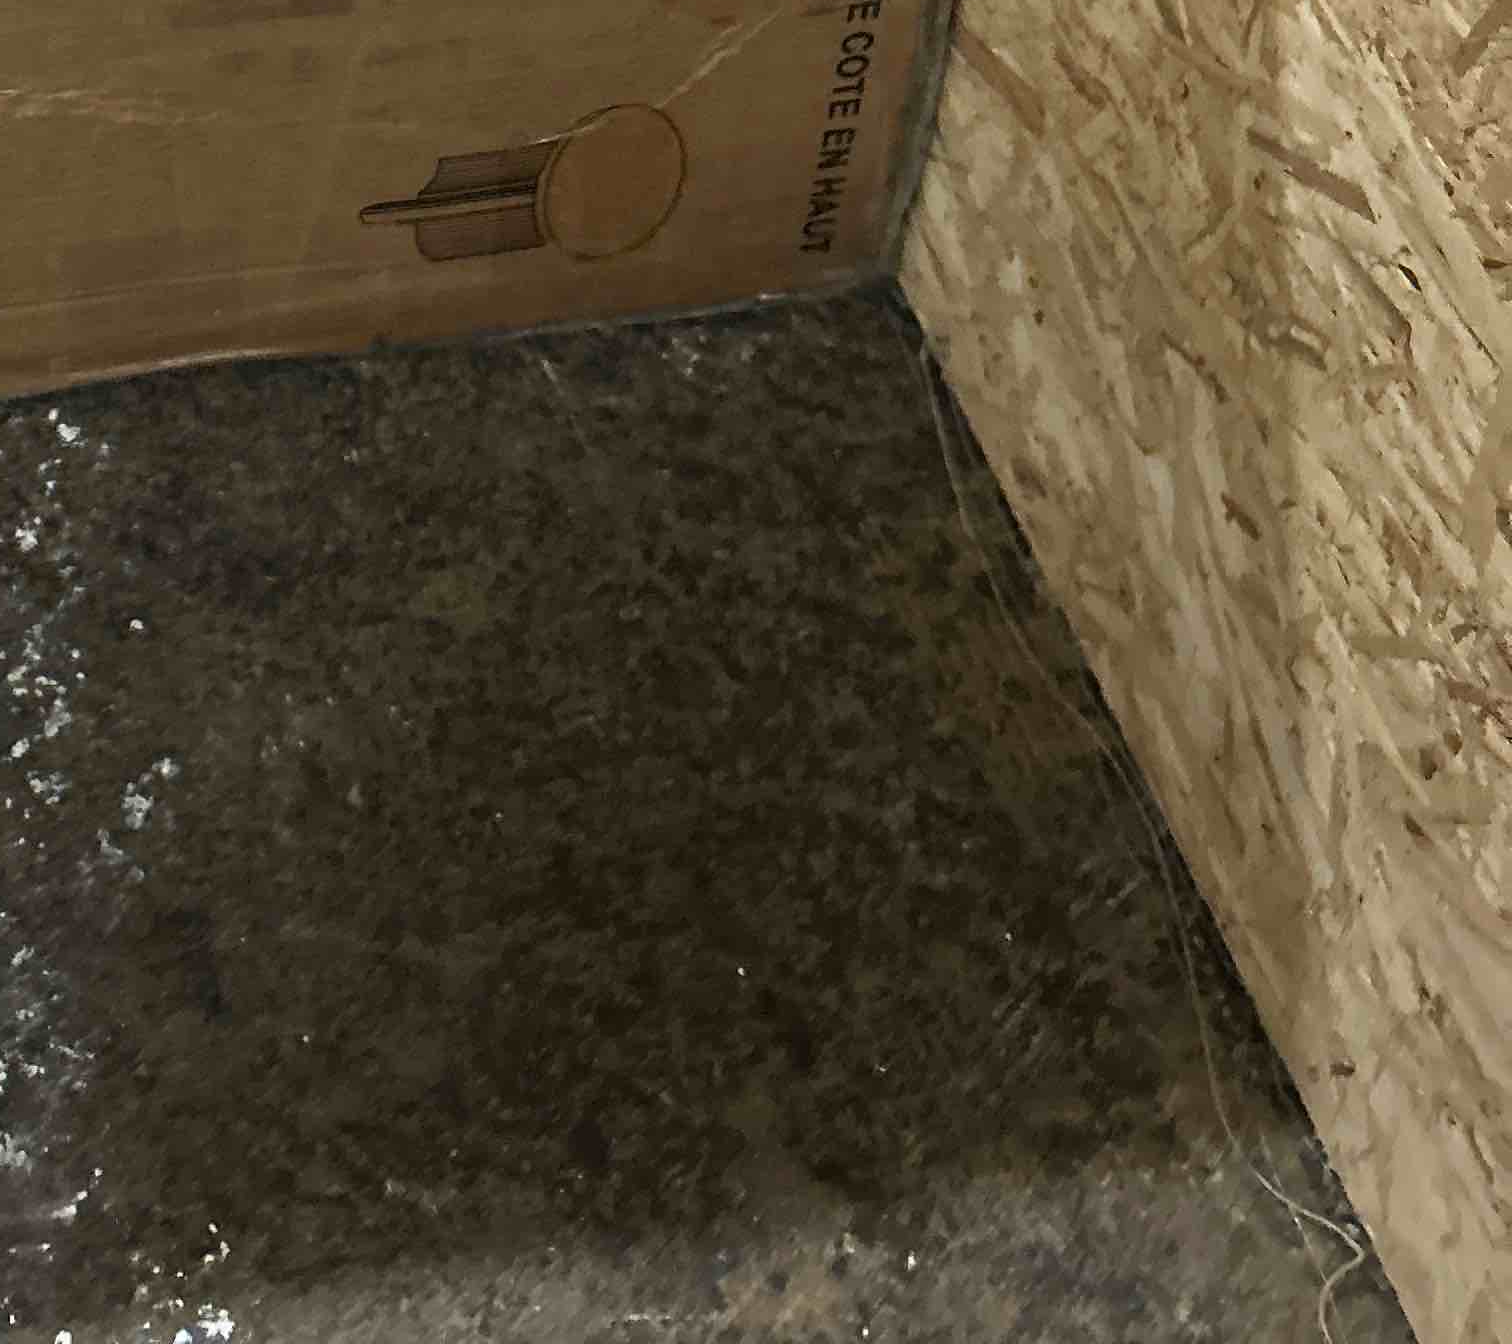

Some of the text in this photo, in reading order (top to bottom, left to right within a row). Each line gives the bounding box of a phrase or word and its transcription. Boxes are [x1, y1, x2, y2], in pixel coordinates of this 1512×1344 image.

[828, 31, 876, 120] COTE
[818, 127, 856, 170] EN
[799, 176, 848, 254] HAUT
